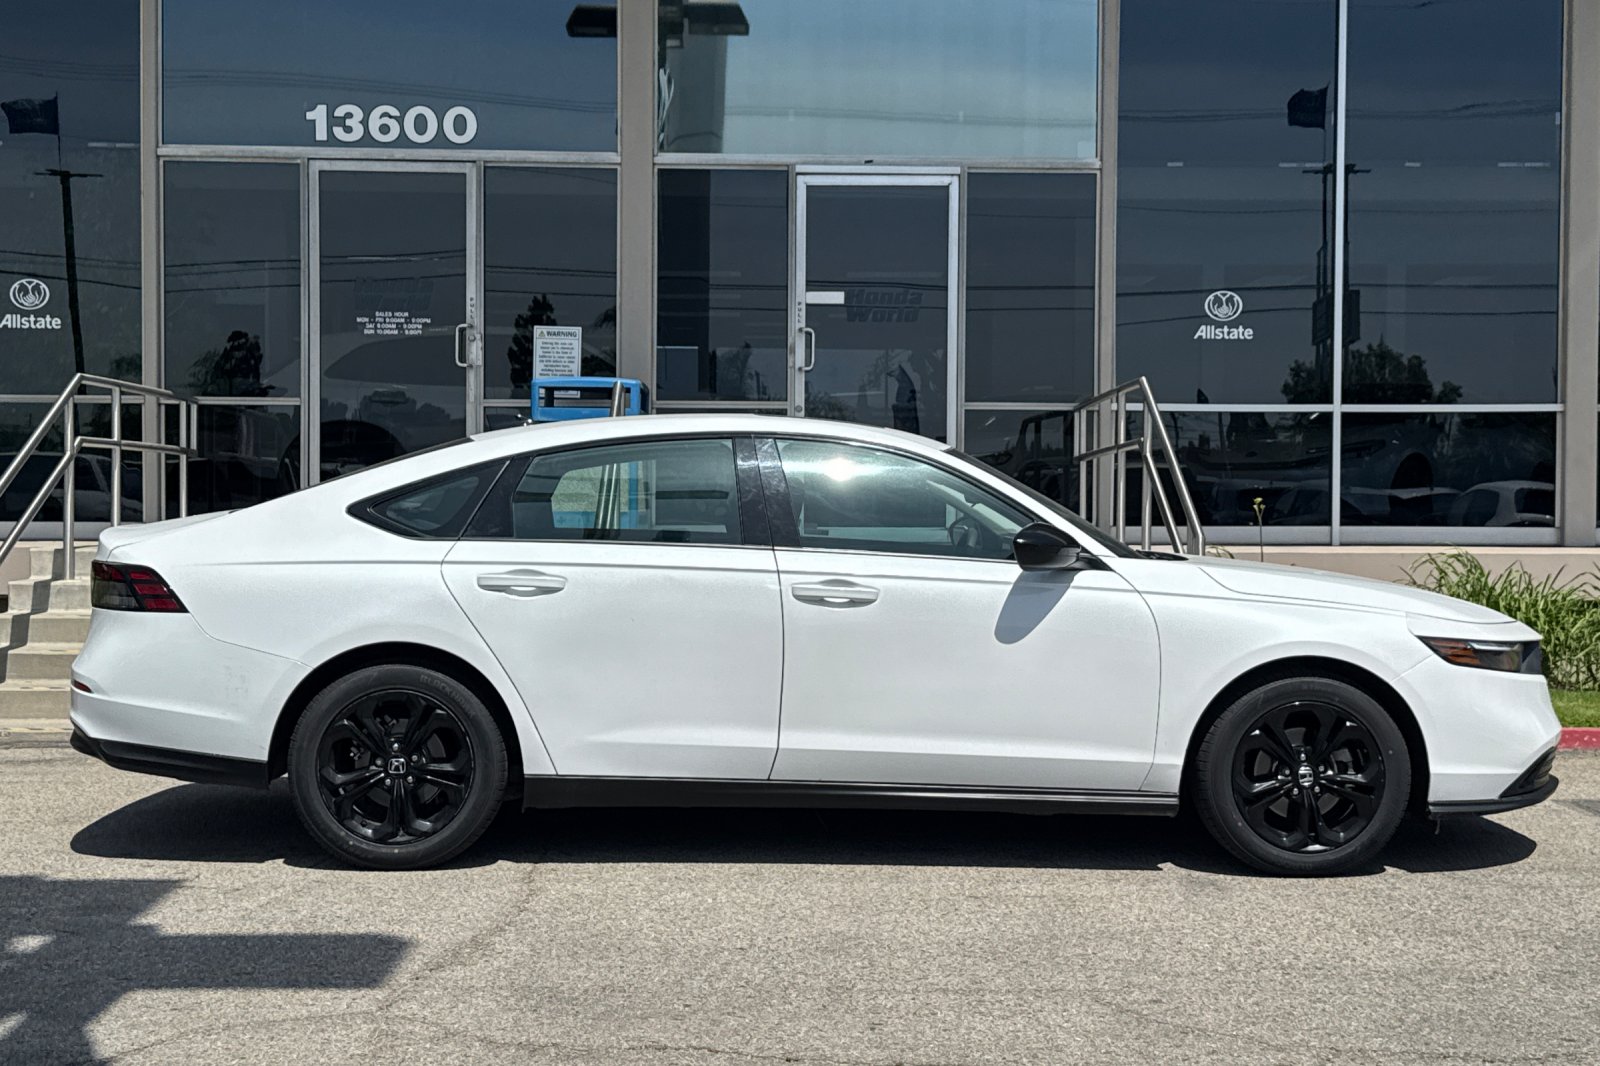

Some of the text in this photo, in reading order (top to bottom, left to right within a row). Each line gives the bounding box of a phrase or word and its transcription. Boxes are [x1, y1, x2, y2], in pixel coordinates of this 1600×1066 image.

[305, 103, 478, 144] 13600
[846, 288, 923, 305] Honda
[0, 313, 62, 329] Allstate
[846, 305, 920, 322] World
[546, 330, 577, 338] WARNING
[1193, 324, 1254, 340] Allstate
